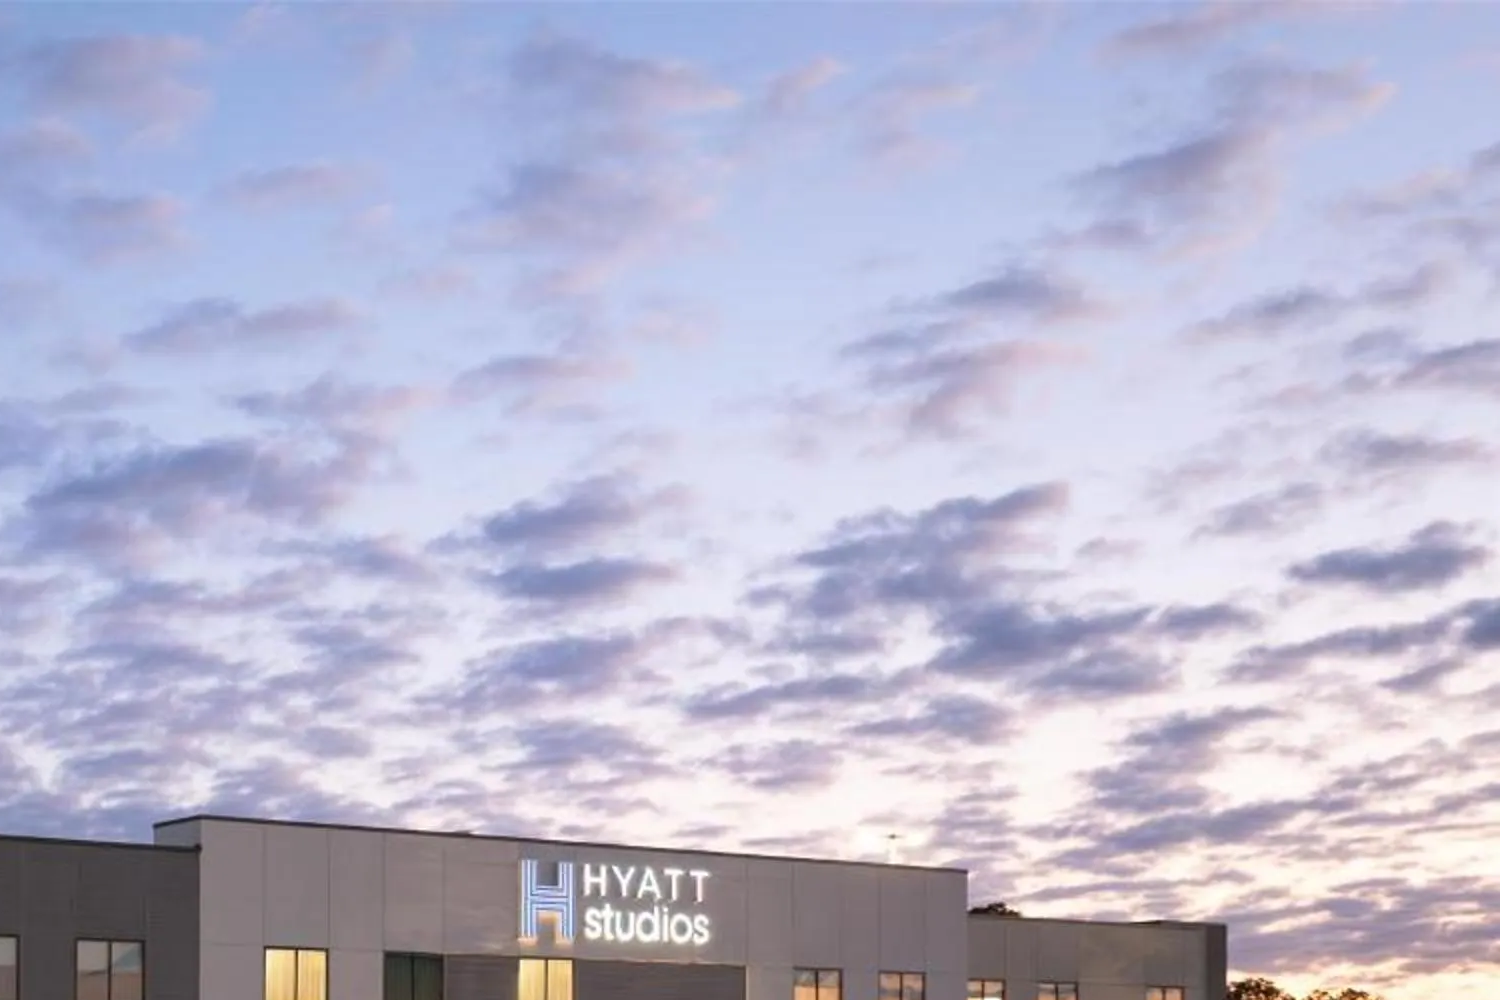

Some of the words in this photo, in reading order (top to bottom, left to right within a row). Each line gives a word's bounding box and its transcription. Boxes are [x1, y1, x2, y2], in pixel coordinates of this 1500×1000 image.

[520, 859, 575, 941] H
[583, 863, 710, 903] HYATT
[584, 903, 711, 944] studios
